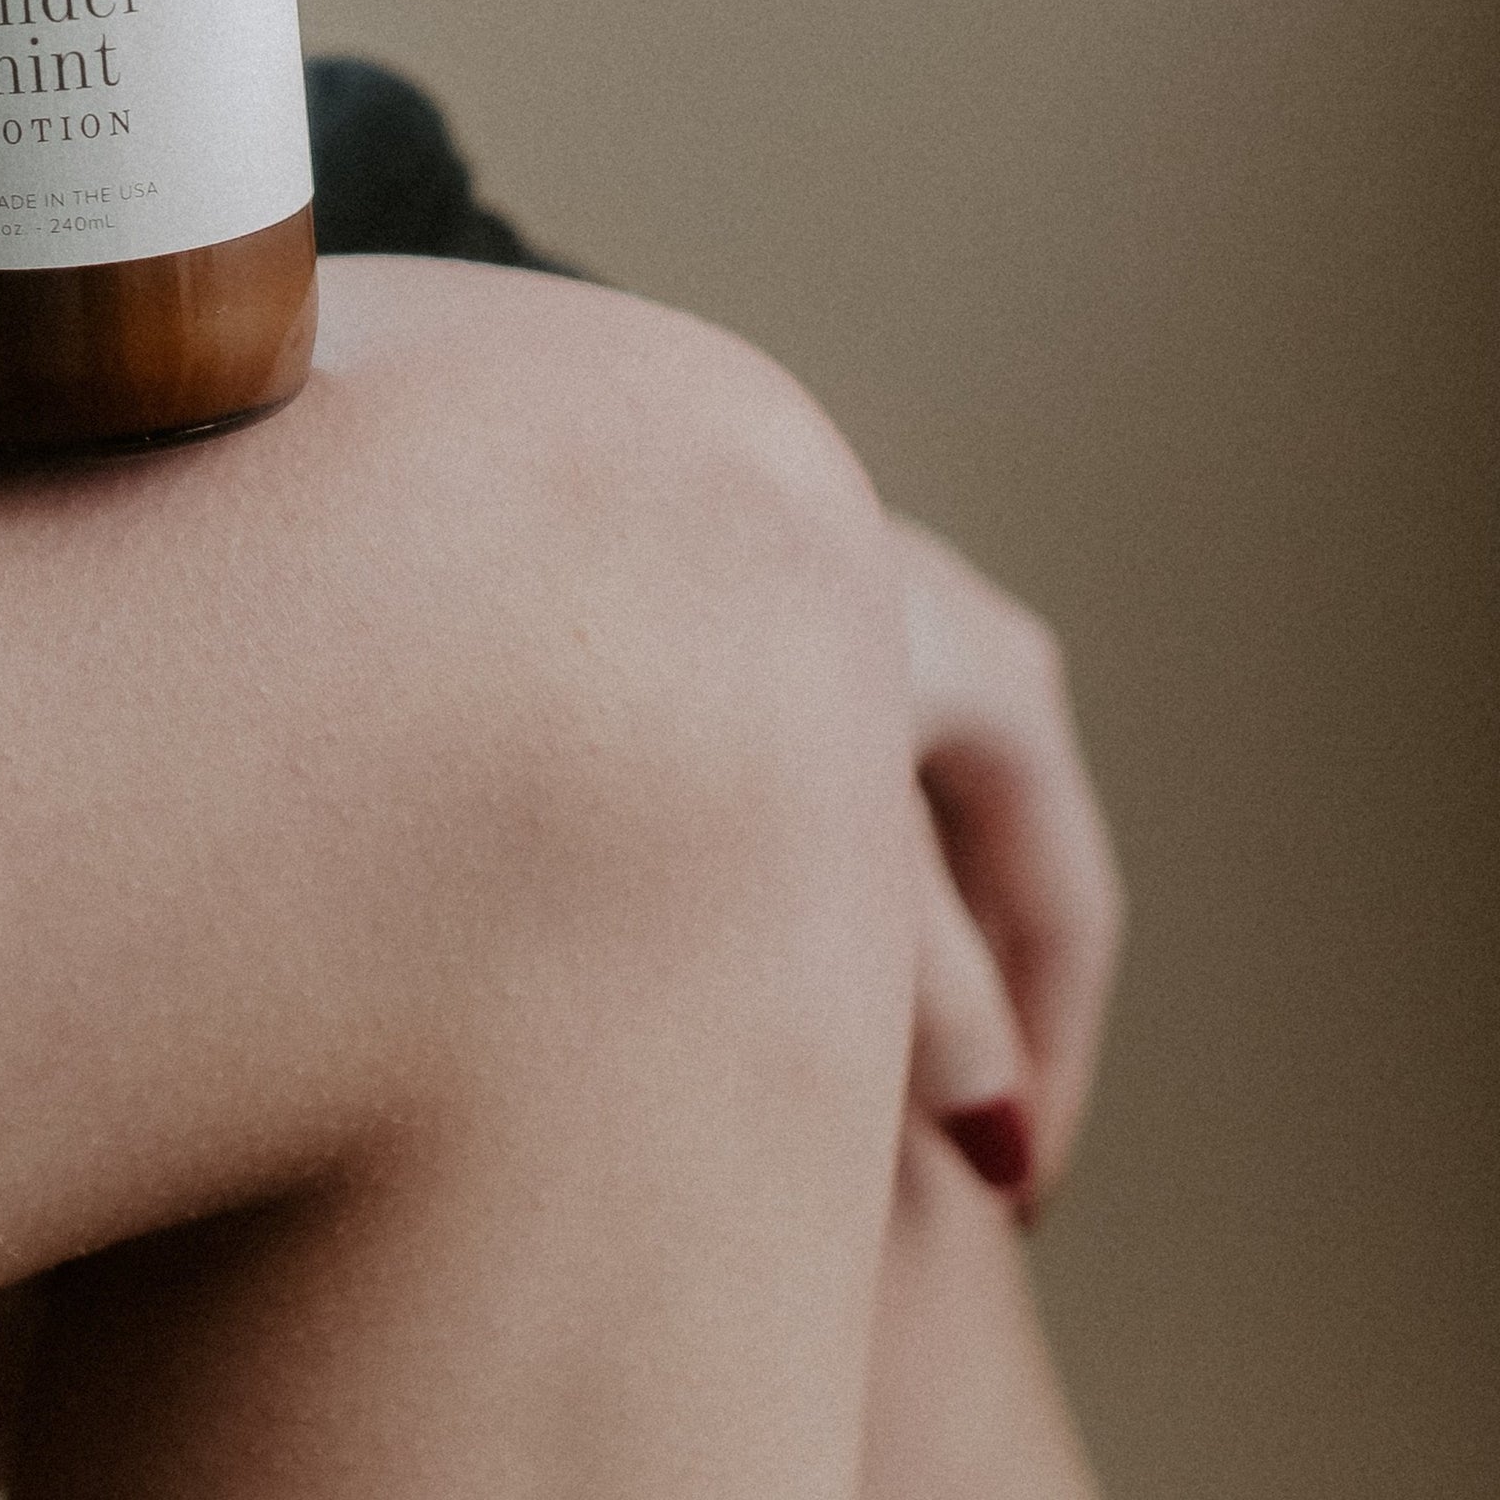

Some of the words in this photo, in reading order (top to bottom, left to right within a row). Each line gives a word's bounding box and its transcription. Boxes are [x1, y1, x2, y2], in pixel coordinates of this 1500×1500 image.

[44, 192, 65, 208] IN
[72, 187, 111, 205] THE
[118, 181, 159, 201] USA
[50, 214, 116, 234] 240mL
